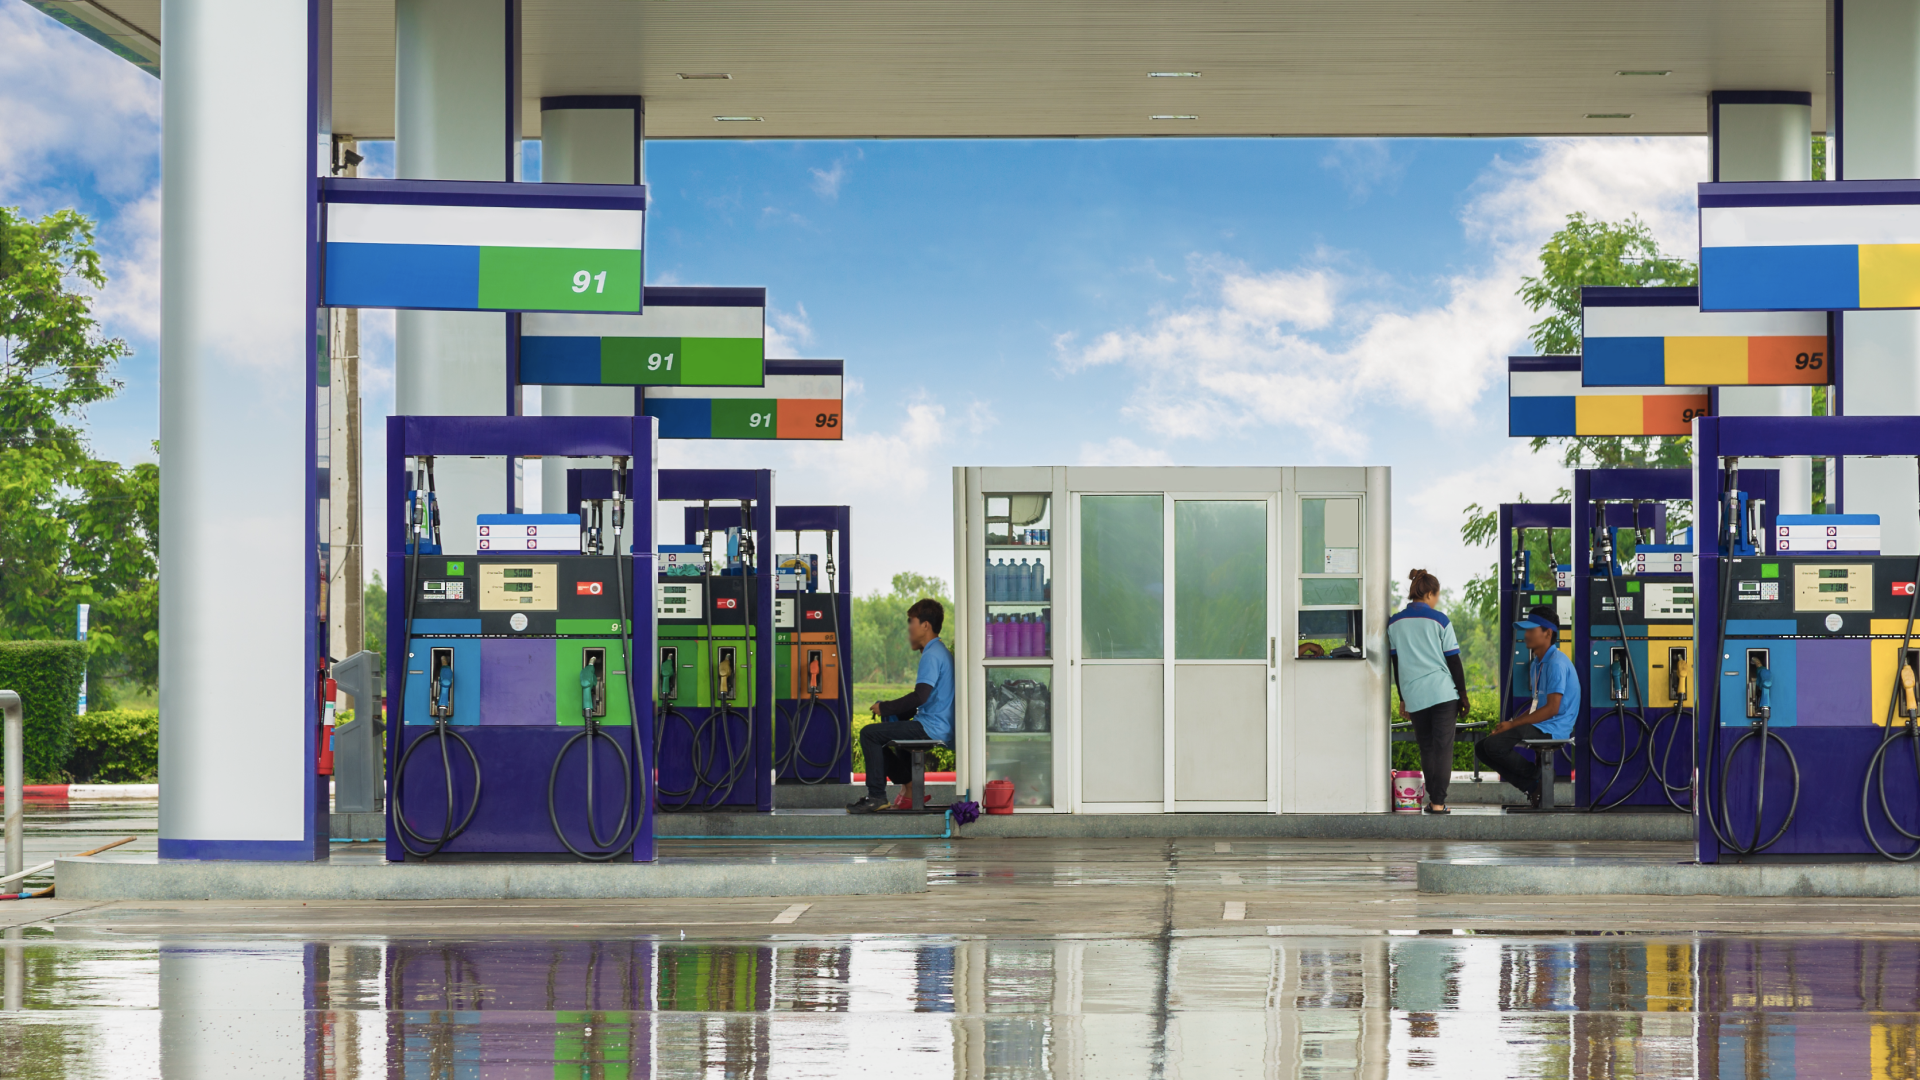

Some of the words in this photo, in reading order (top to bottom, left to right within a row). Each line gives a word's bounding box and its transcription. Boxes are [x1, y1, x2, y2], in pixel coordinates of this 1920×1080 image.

[571, 269, 607, 294] 91
[646, 352, 675, 371] 91
[1795, 352, 1824, 371] 95
[749, 413, 772, 428] 91
[815, 413, 839, 428] 95
